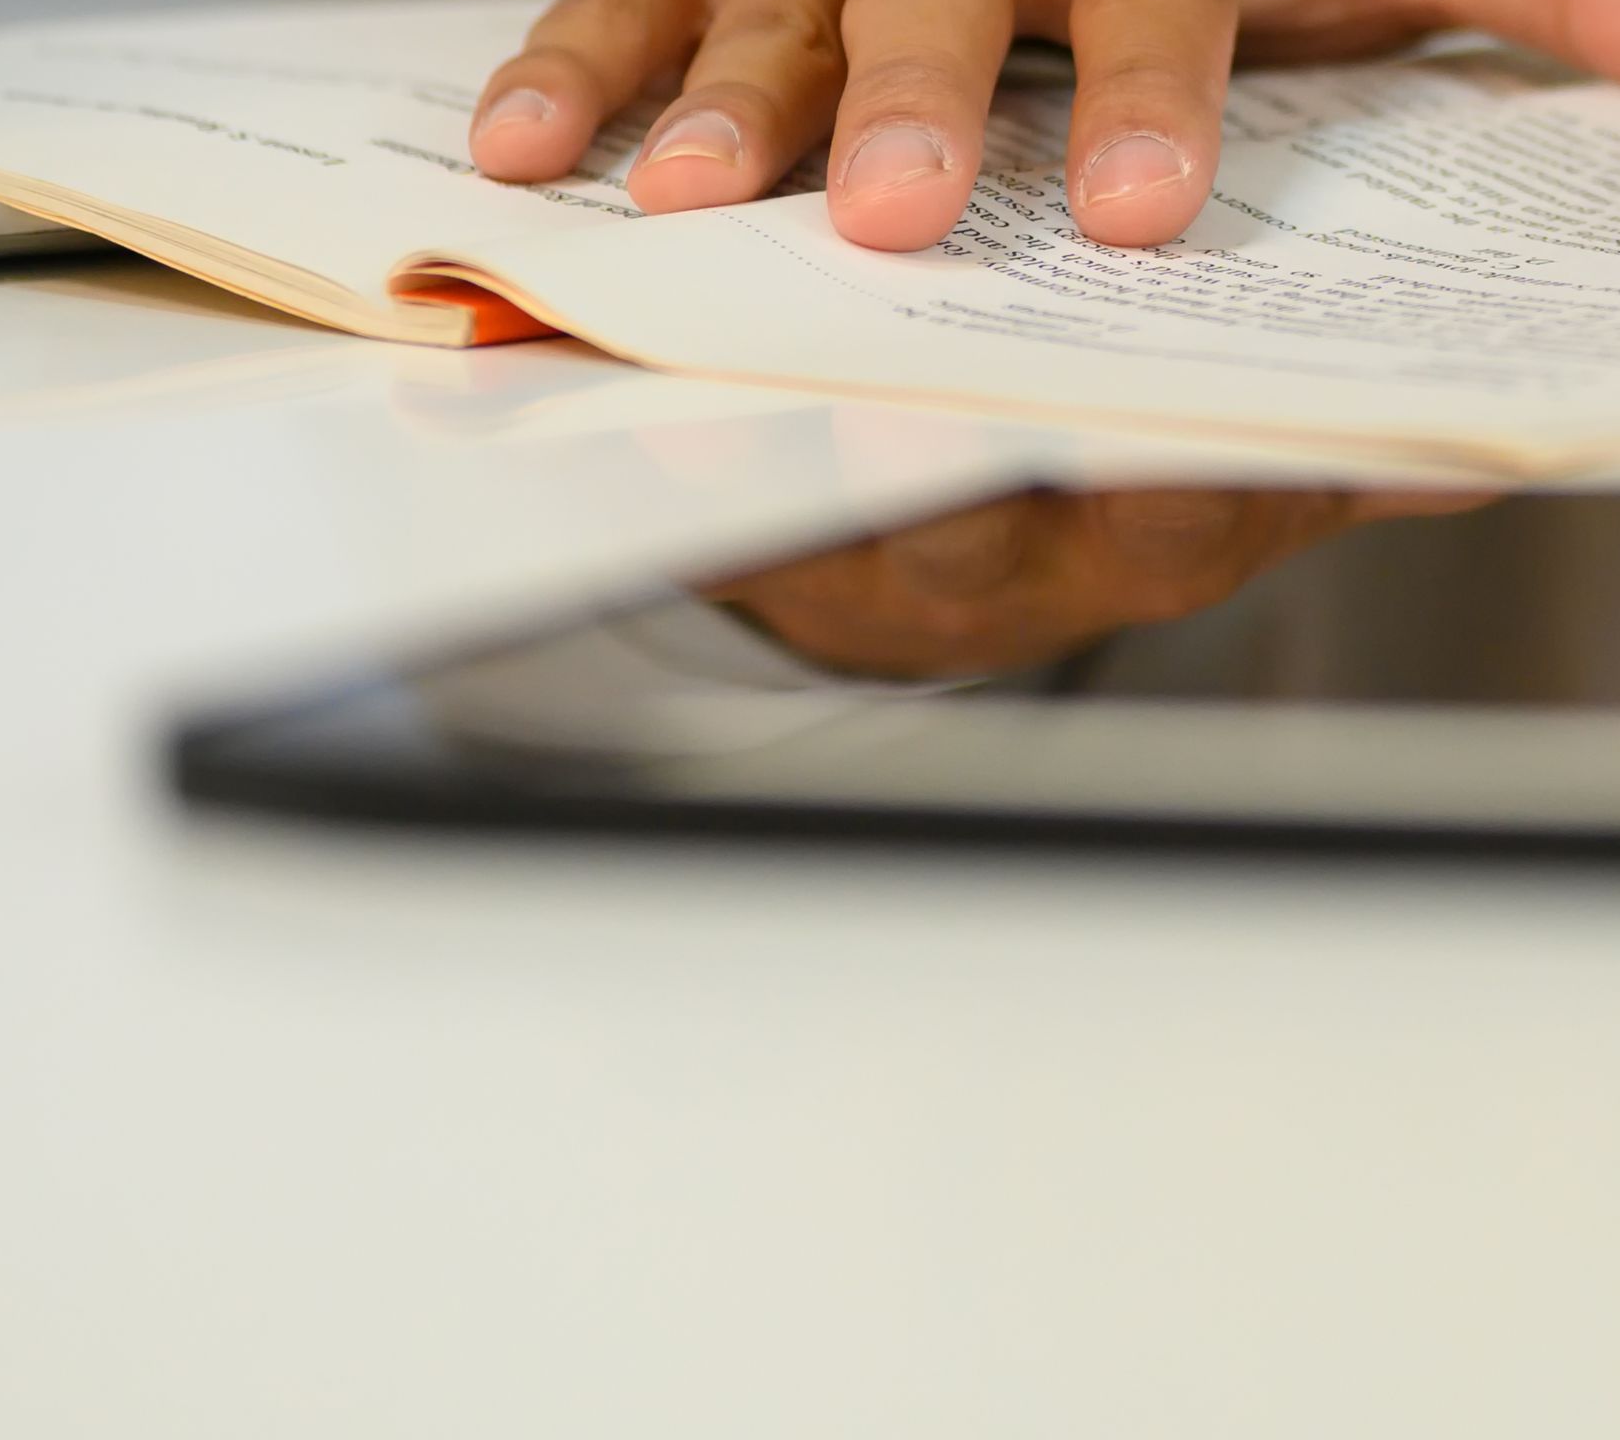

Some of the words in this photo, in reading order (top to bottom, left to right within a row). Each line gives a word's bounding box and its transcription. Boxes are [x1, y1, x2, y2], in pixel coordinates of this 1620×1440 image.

[1210, 188, 1297, 232] conserv
[1013, 233, 1056, 253] the
[1043, 226, 1127, 260] energy
[1297, 232, 1381, 256] energy
[1003, 250, 1137, 294] households
[1061, 252, 1130, 279] much
[1184, 260, 1261, 281] suffer
[1192, 248, 1279, 271] energy
[1381, 252, 1478, 276] towards
[976, 257, 1087, 298] Germany,
[1130, 260, 1219, 287] world's
